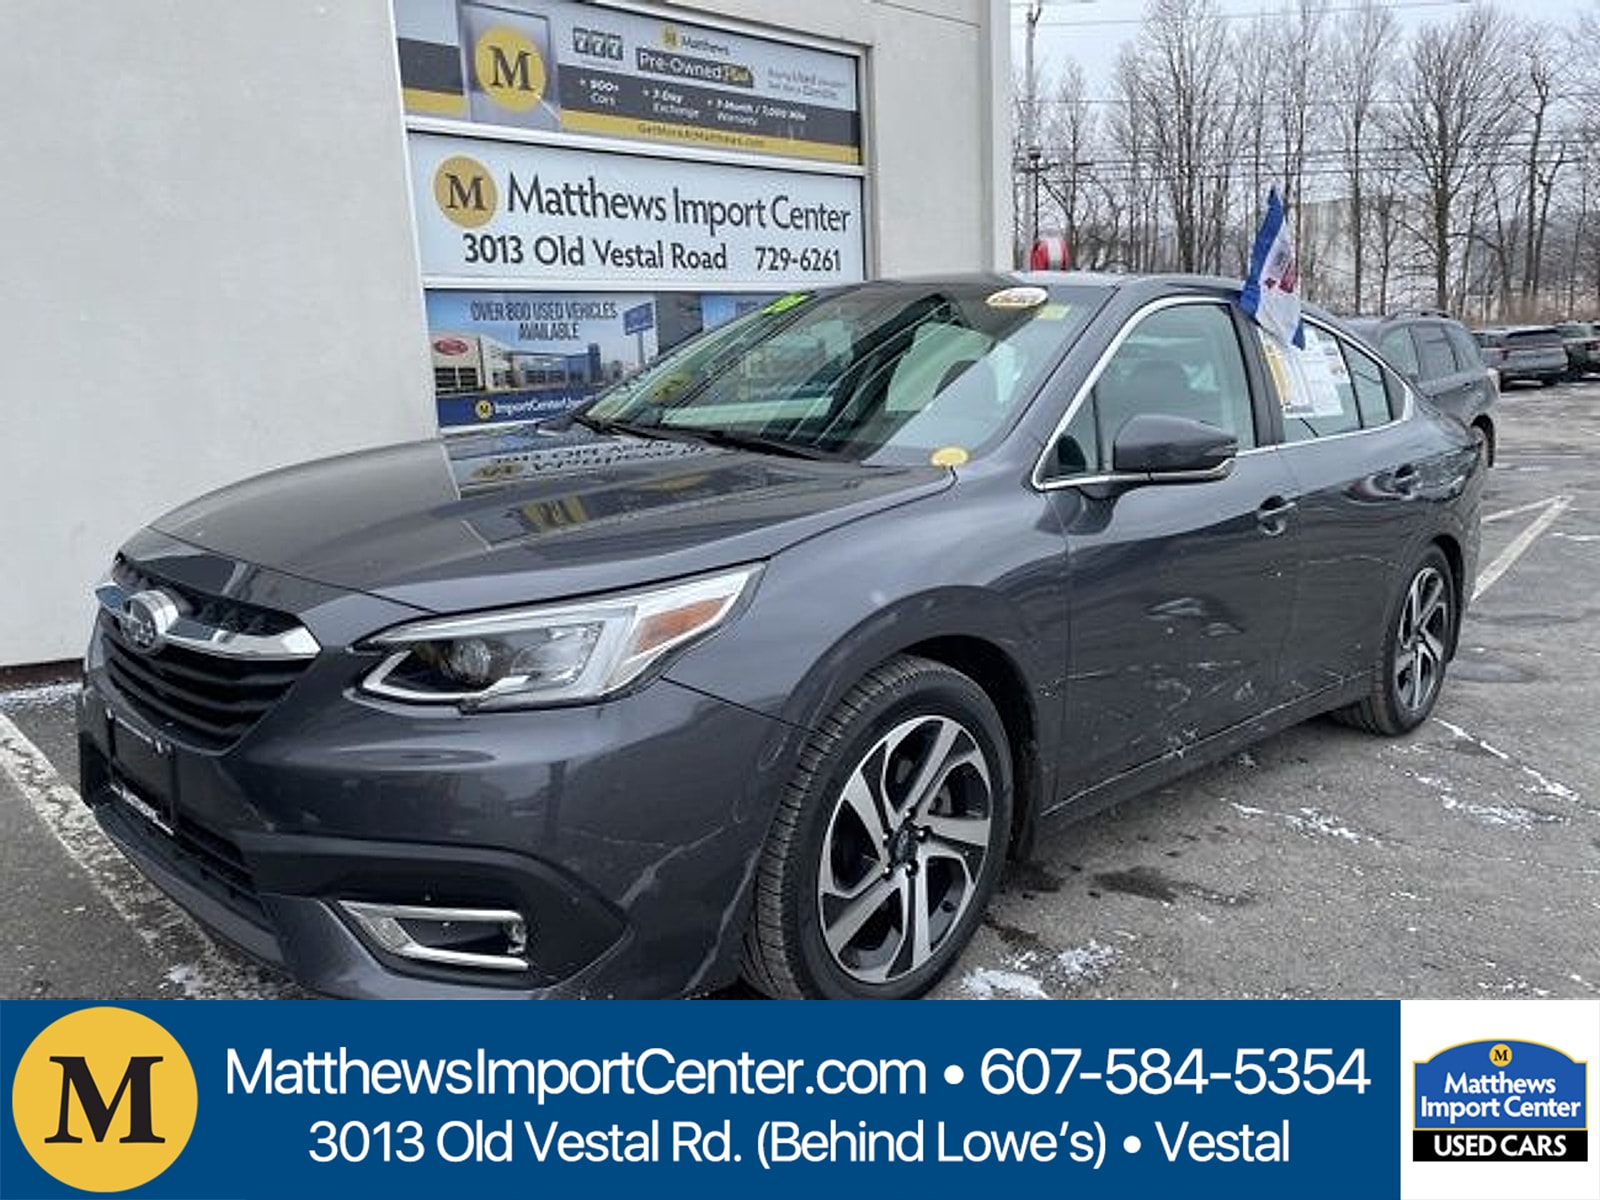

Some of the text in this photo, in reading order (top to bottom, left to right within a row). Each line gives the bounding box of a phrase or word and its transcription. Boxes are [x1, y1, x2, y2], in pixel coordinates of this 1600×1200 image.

[490, 45, 532, 91] M
[640, 51, 721, 80] Pre-Owned
[445, 172, 484, 211] M
[507, 171, 851, 237] Matthews Import Center
[463, 234, 841, 272] 3013 Old Vestal Road 729-6261
[470, 301, 505, 321] OVER
[533, 301, 565, 320] USED
[566, 302, 618, 320] VEHICLES
[517, 323, 581, 341] AVAILABLE
